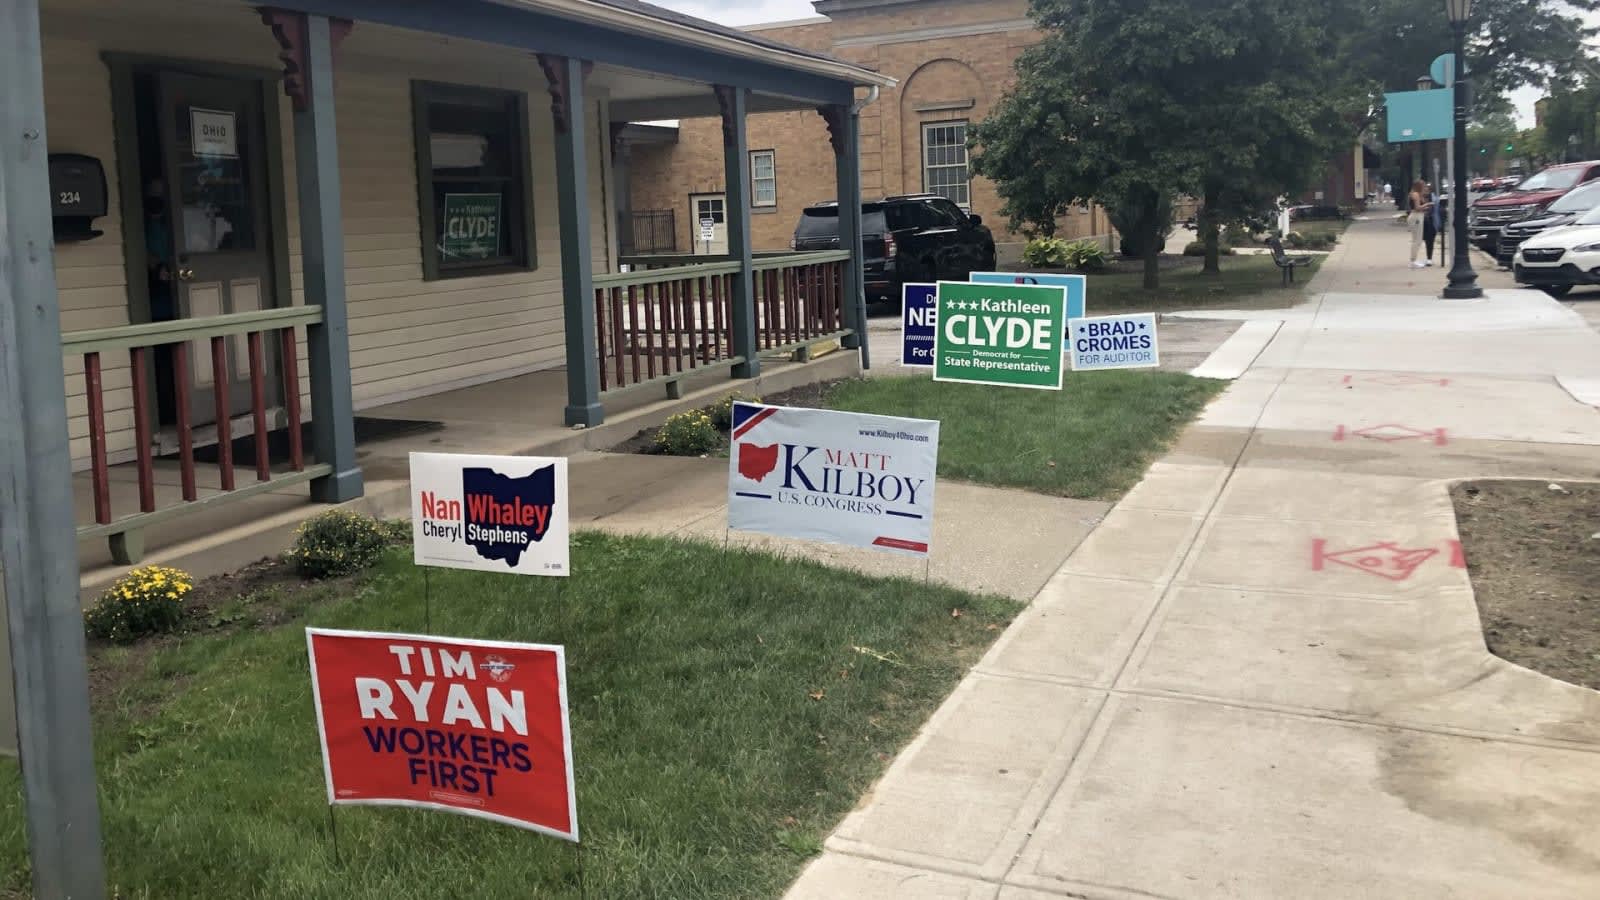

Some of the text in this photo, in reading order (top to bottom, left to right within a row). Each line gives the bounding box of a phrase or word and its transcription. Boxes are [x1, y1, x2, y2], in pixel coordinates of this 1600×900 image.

[202, 124, 226, 137] OHIO
[60, 191, 81, 204] 234
[449, 216, 497, 239] CLYDE
[981, 298, 1051, 315] Kathleen
[945, 314, 1052, 350] CLYDE
[1088, 320, 1136, 337] BRAD
[912, 347, 928, 357] For
[972, 349, 1021, 359] Democrat for
[1076, 335, 1151, 353] CROMES
[944, 356, 1051, 374] State Representative
[1079, 351, 1151, 365] FOR AUDITOR
[825, 449, 892, 471] MATT
[780, 443, 925, 505] KILBOY
[421, 490, 549, 535] Nan Whaley
[777, 491, 882, 517] U.S. CONGRESS
[422, 520, 528, 546] Cheryl Stephens
[389, 645, 476, 681] TIM
[355, 676, 529, 737] RYAN
[363, 726, 532, 772] WORKERS
[408, 757, 498, 797] FIRST
